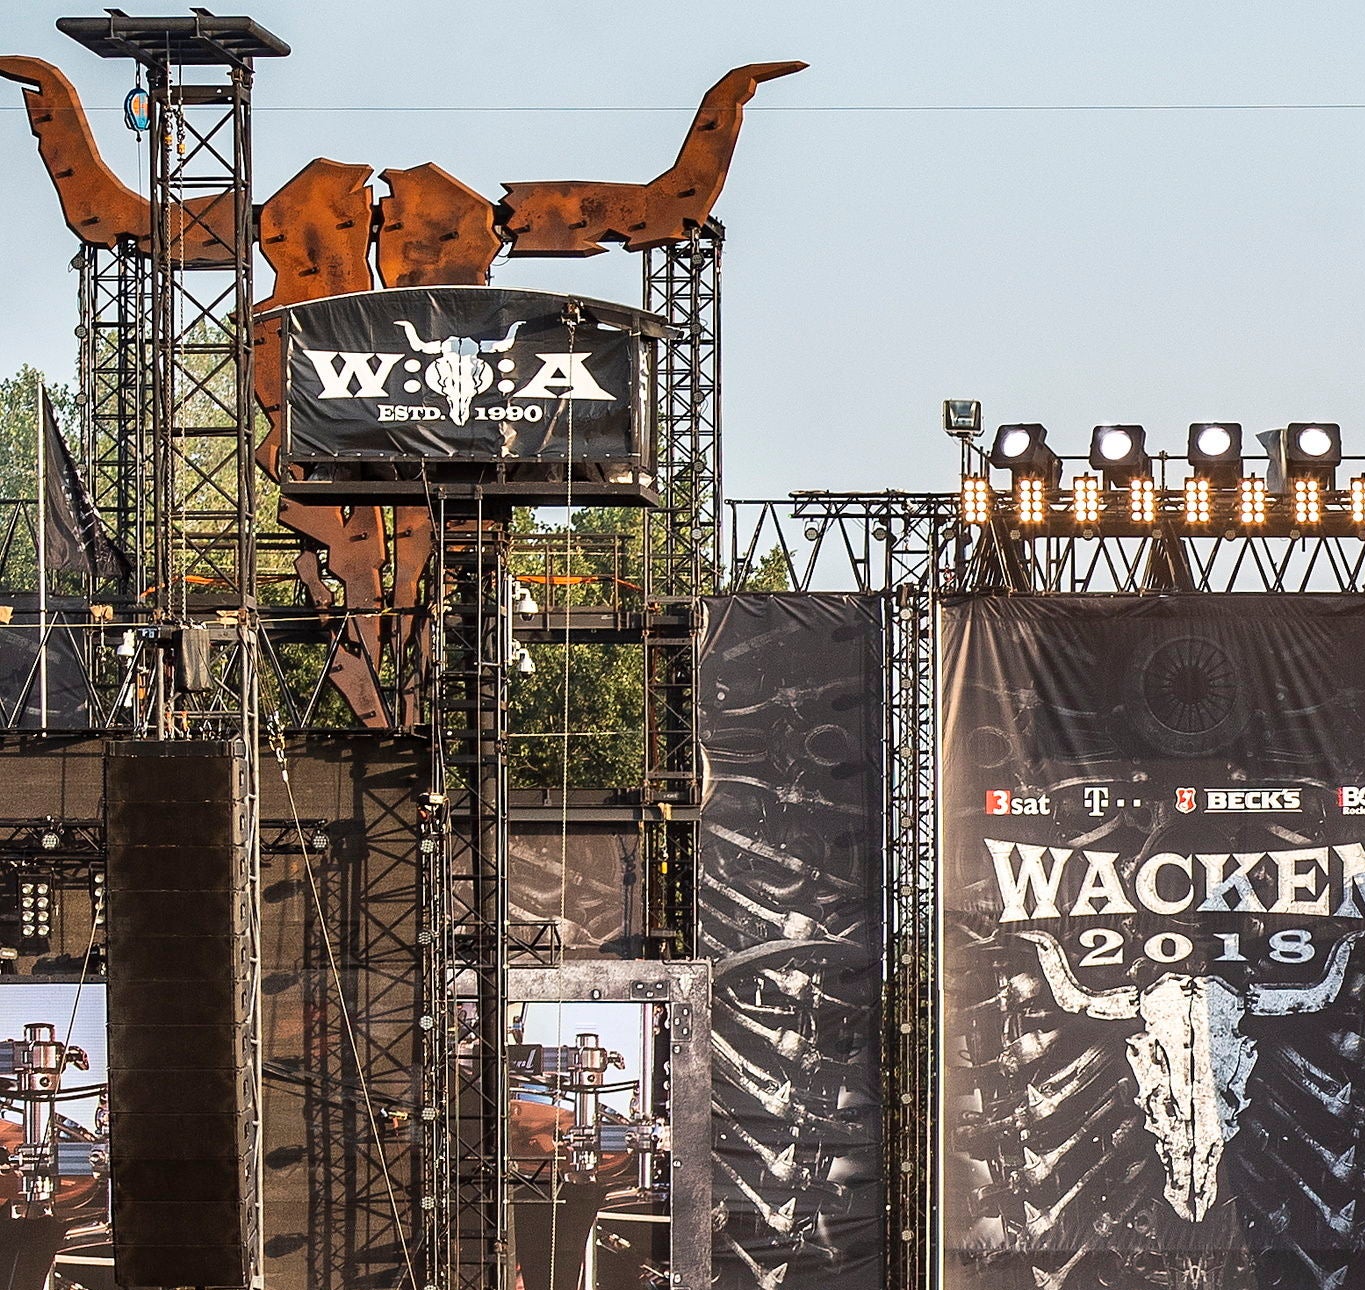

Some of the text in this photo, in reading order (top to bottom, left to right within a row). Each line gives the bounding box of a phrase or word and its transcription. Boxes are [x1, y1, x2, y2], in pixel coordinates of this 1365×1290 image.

[377, 403, 543, 423] ESTD. 1990
[1207, 788, 1302, 811] BECK'S
[1079, 928, 1316, 967] 2018
